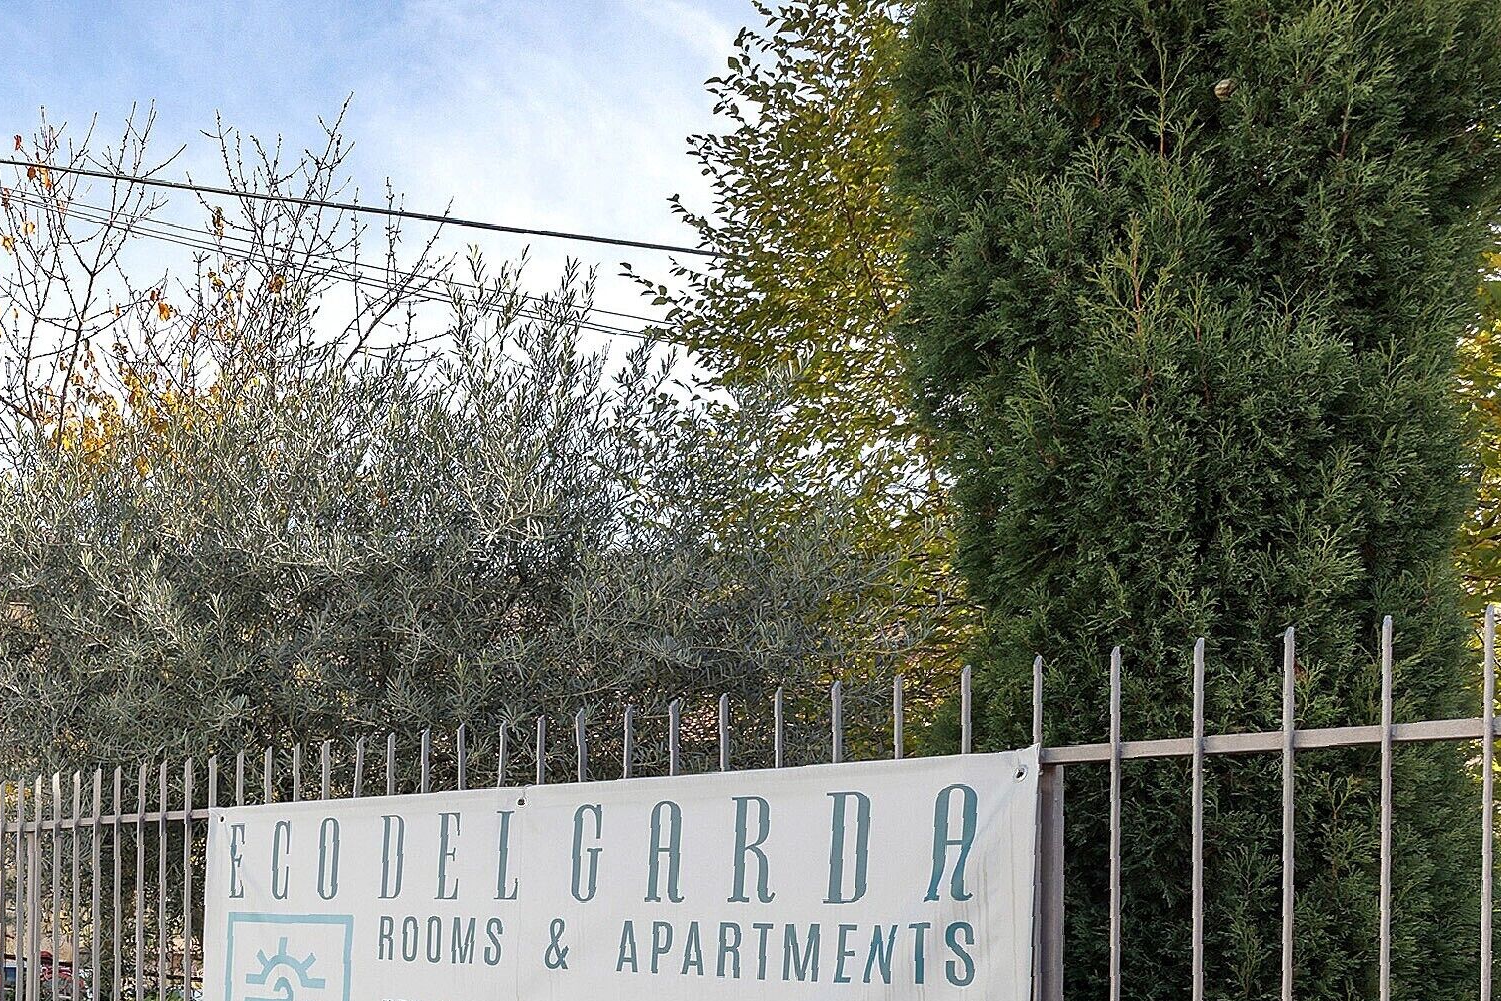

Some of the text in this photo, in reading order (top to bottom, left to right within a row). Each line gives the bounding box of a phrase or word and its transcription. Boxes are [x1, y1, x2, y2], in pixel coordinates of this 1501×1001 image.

[378, 915, 977, 987] ROOMS & APARTMENTS
